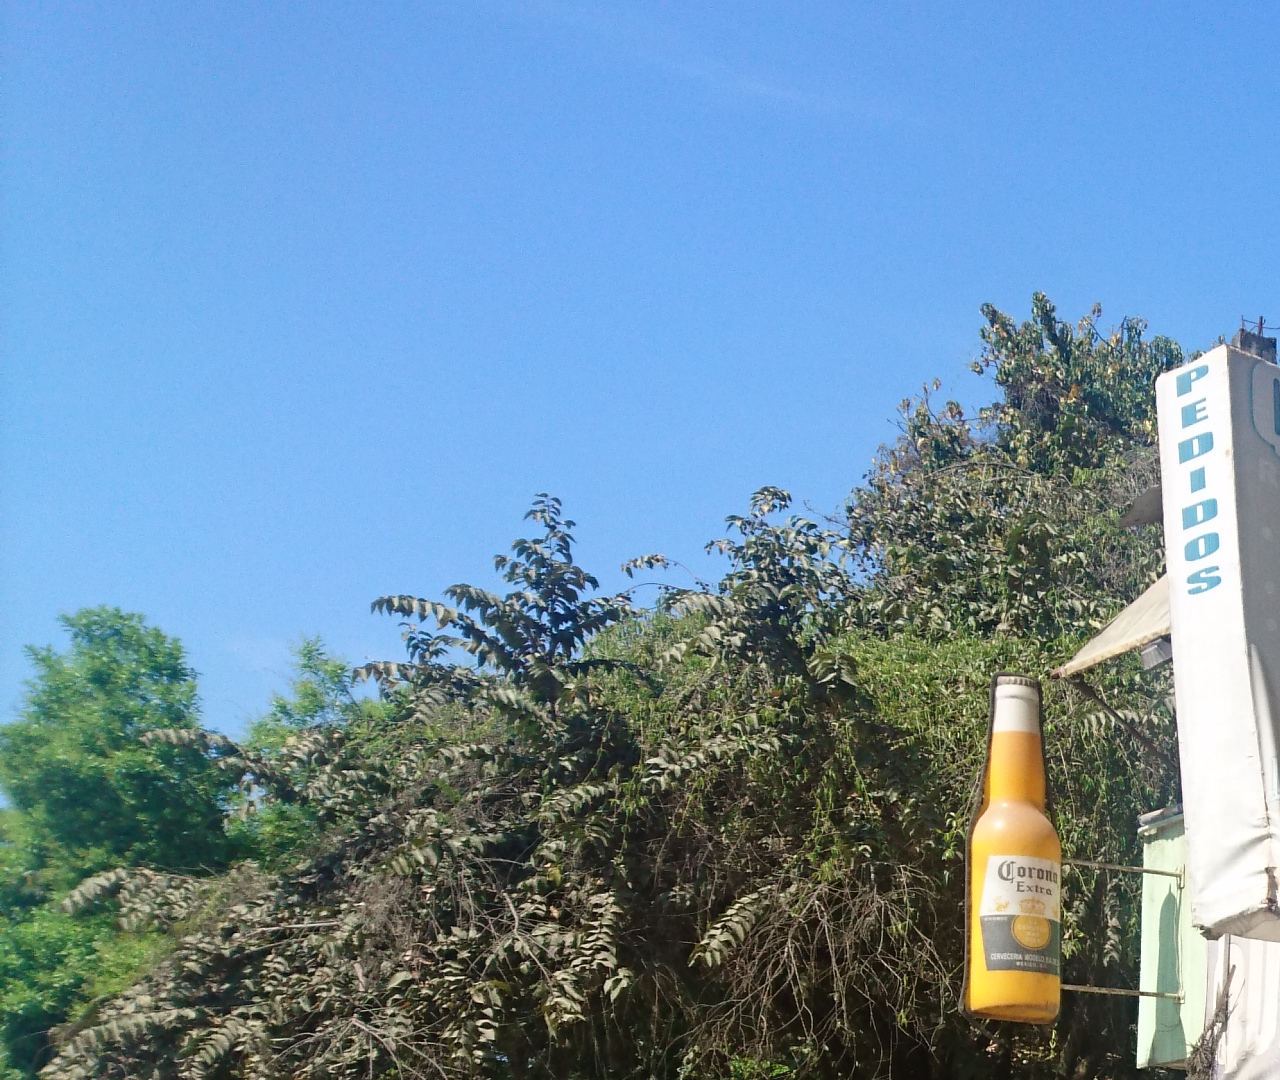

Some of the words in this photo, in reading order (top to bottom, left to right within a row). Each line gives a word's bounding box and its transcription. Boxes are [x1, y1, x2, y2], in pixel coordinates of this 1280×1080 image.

[1176, 364, 1222, 596] PEDIDOS
[997, 860, 1058, 884] Corona
[1016, 881, 1053, 896] Extra
